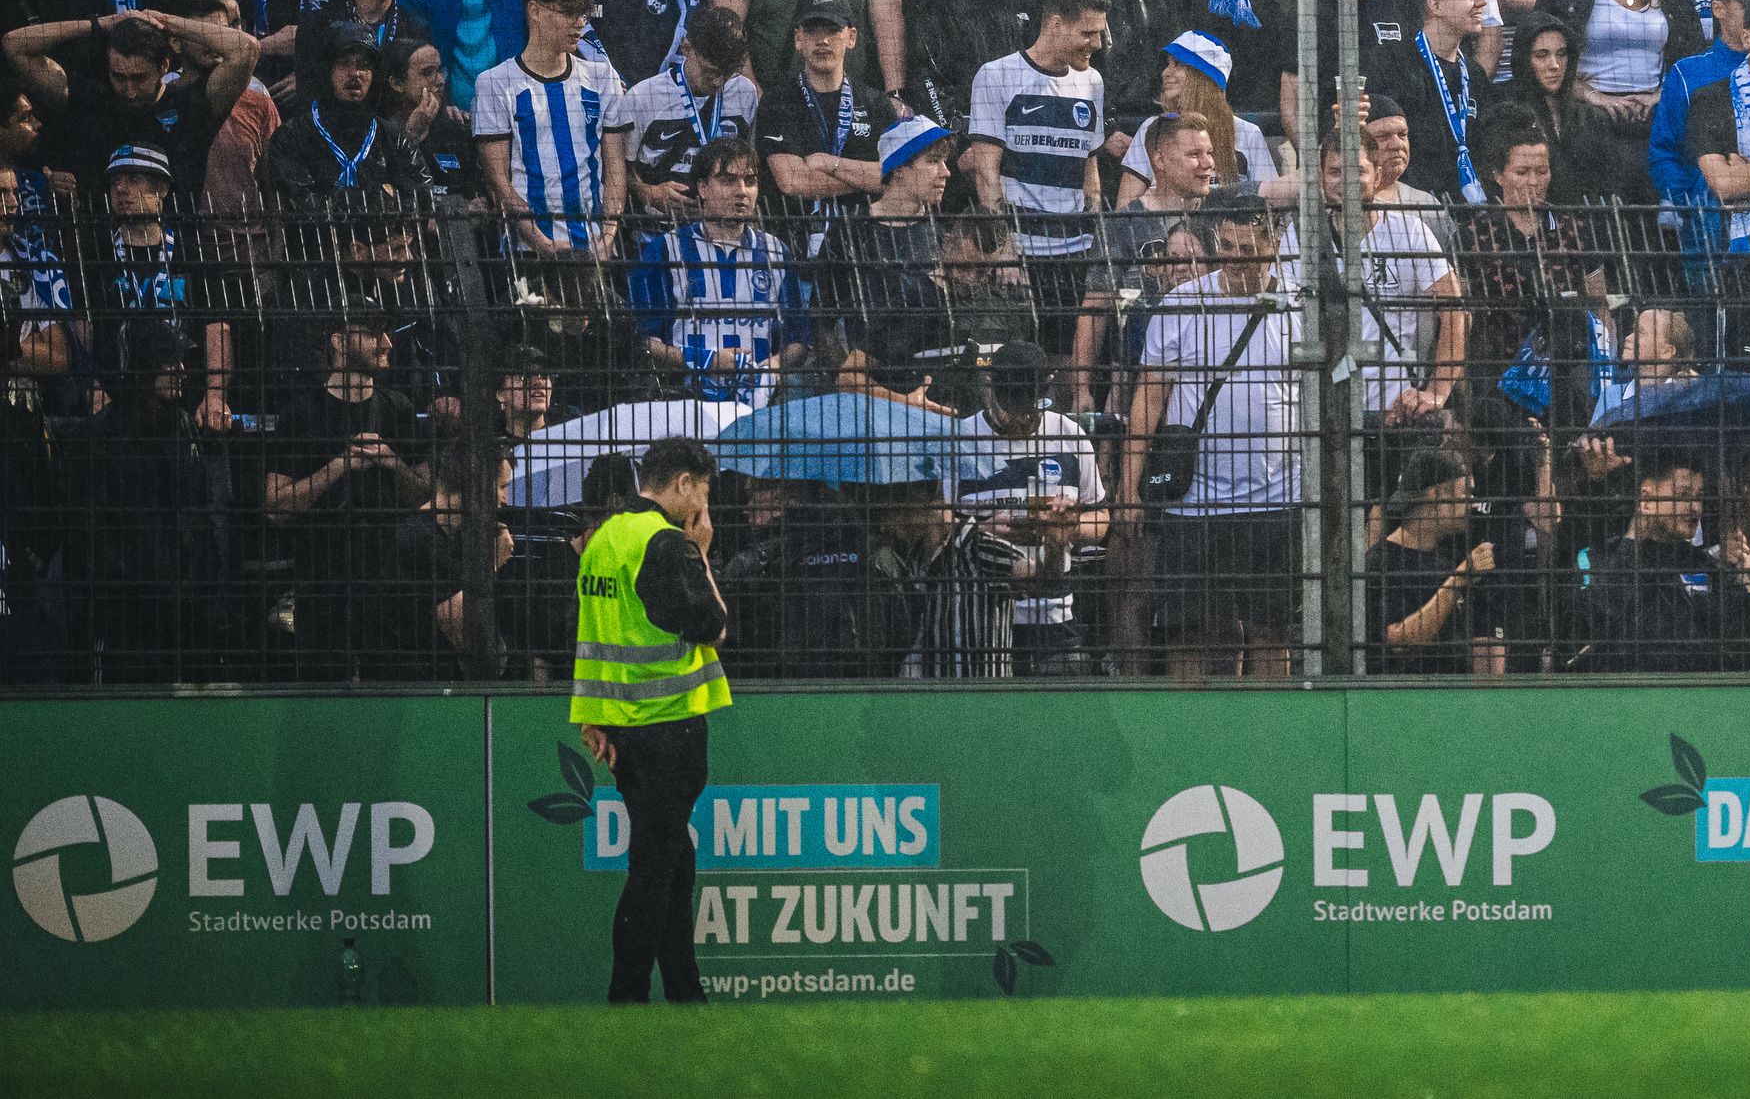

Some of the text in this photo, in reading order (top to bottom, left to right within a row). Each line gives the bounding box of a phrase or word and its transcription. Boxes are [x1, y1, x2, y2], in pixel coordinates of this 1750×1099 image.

[1014, 134, 1031, 146] DER
[188, 801, 435, 897] EWP
[713, 797, 810, 857] MIT
[823, 796, 928, 856] UNS
[1313, 793, 1556, 887] EWP
[188, 909, 432, 932] Stadtwerke Potsdam
[694, 883, 1014, 944] AT ZUKUNFT
[1313, 900, 1553, 922] Stadtwerke Potsdam
